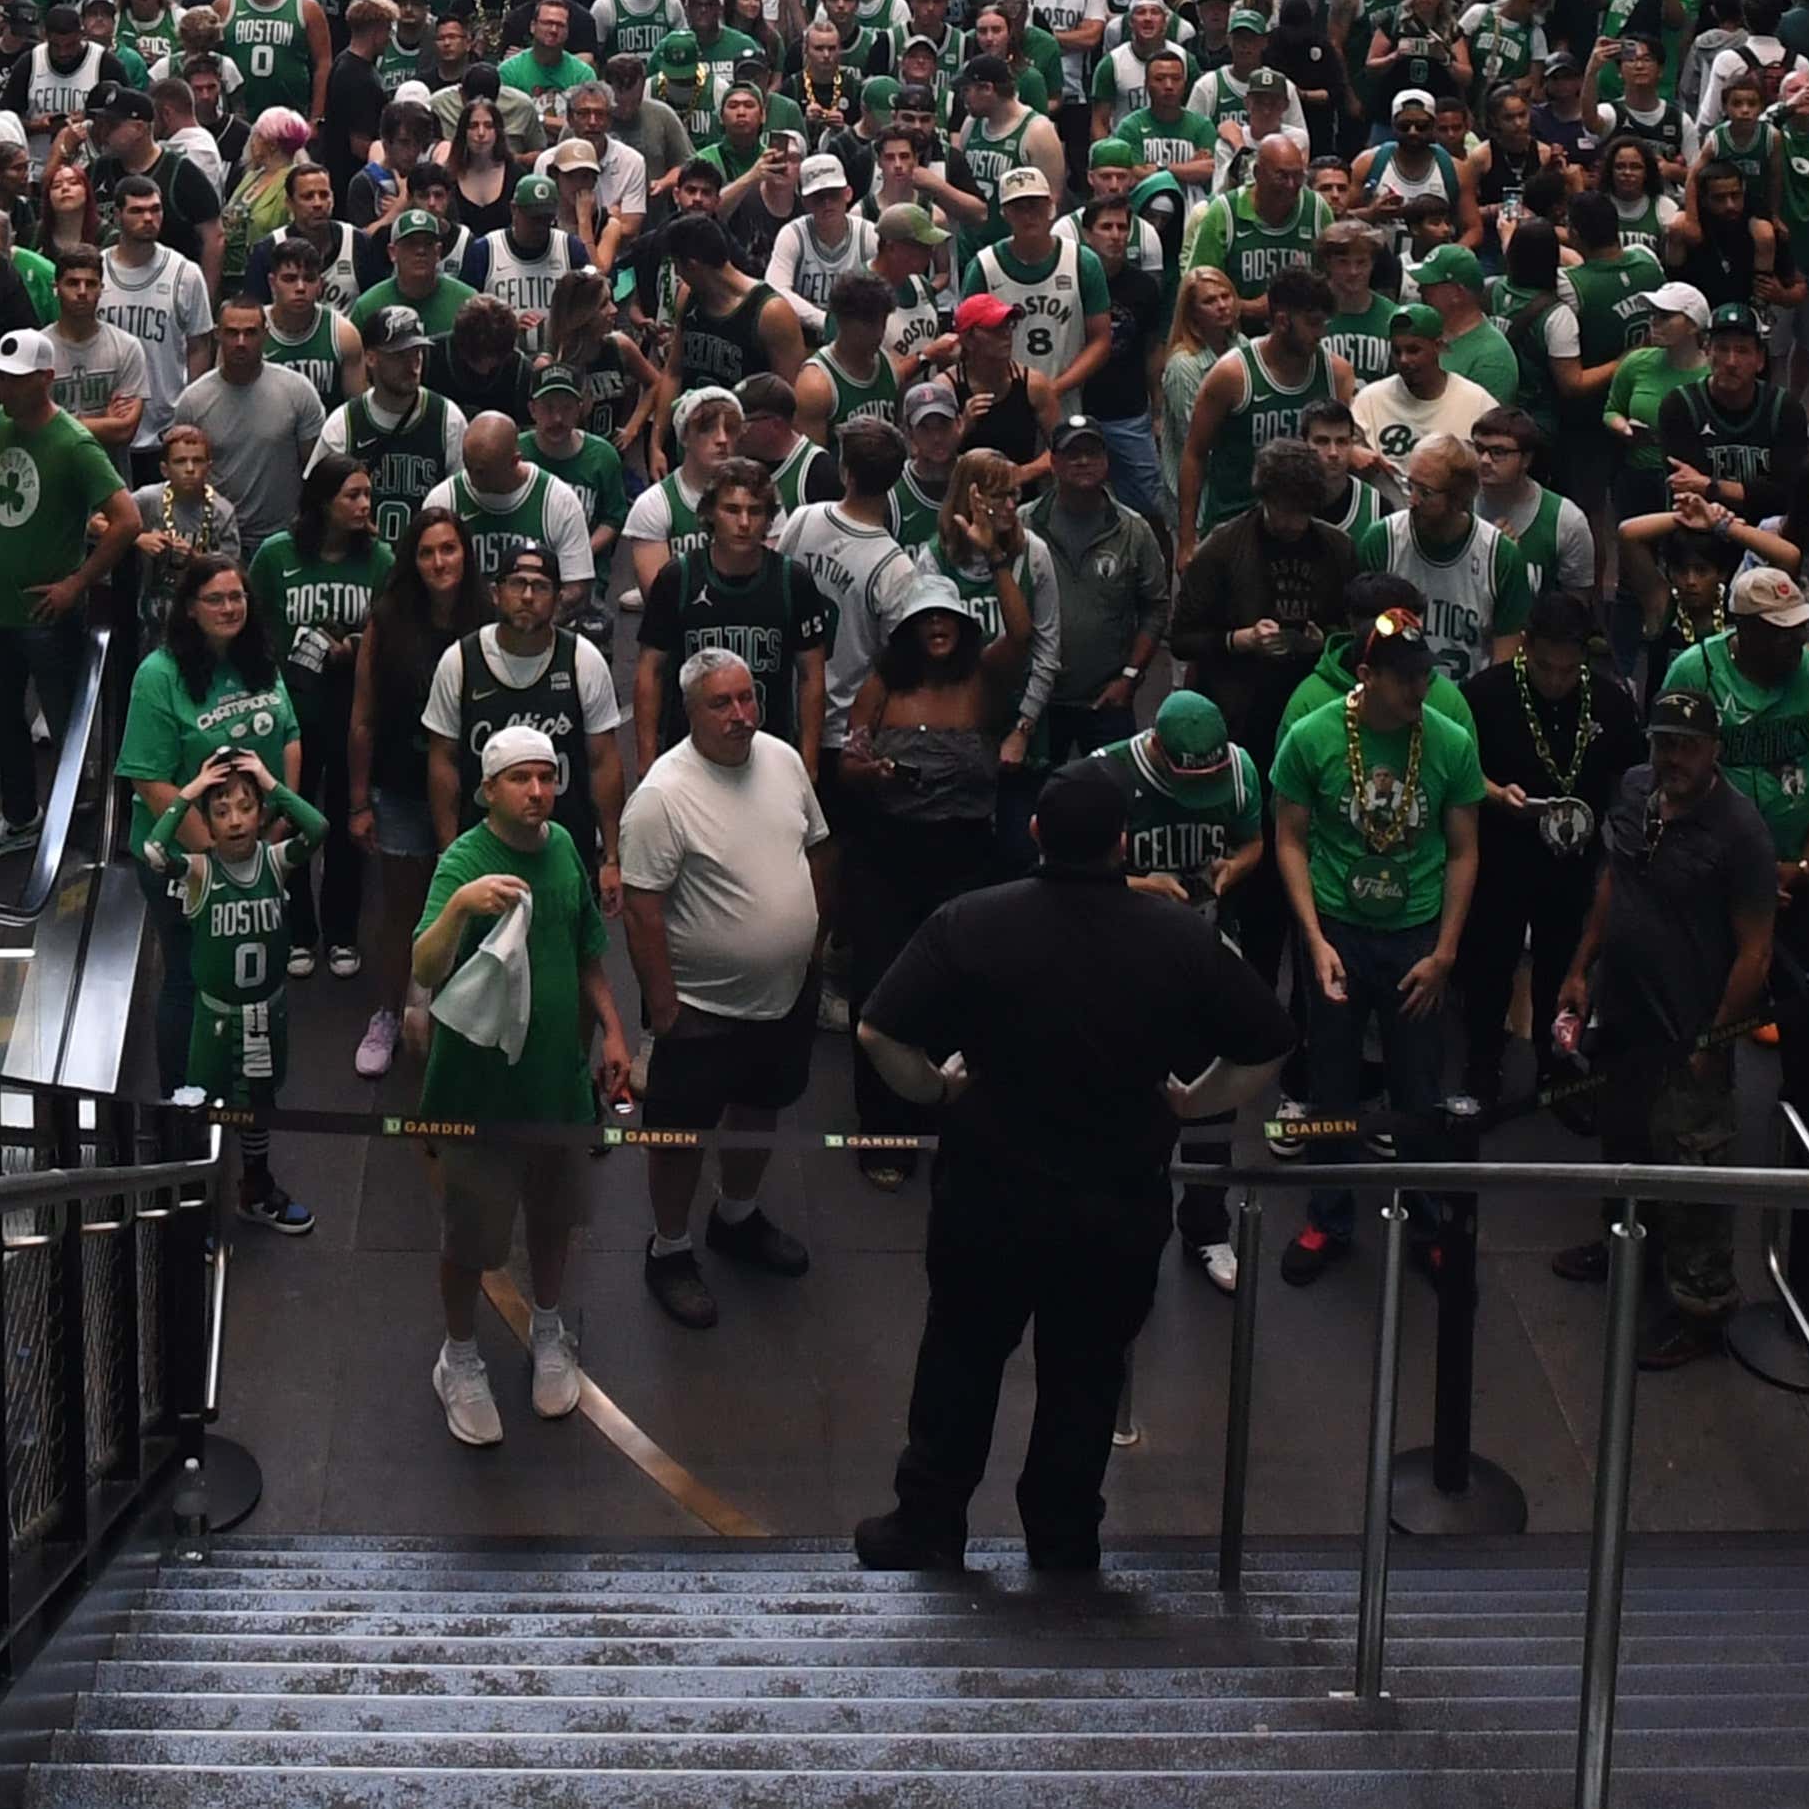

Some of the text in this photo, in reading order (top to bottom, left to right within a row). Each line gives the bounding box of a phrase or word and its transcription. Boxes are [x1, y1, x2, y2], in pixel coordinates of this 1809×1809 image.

[235, 20, 294, 47] BOSTON
[251, 46, 274, 77] 0
[1260, 73, 1274, 86] B
[495, 278, 562, 311] CELTIC
[802, 274, 836, 303] CELT
[1017, 295, 1072, 326] OSTON
[1026, 328, 1054, 357] 8
[1252, 411, 1304, 448] BOST
[376, 501, 410, 541] 0
[671, 536, 712, 558] BOS
[805, 552, 856, 596] TATUM
[1423, 598, 1479, 644] LTICS
[685, 625, 784, 674] CELTICS
[196, 693, 281, 730] CHAMPIONS
[1133, 824, 1227, 871] CELTICS
[210, 897, 285, 938] BOSTON
[234, 941, 267, 990] 0
[209, 1110, 255, 1126] RDEN
[404, 1120, 477, 1137] GARDEN
[1285, 1120, 1359, 1135] GARDEN
[625, 1130, 698, 1145] GARDEN
[846, 1135, 920, 1149] GARDEN
